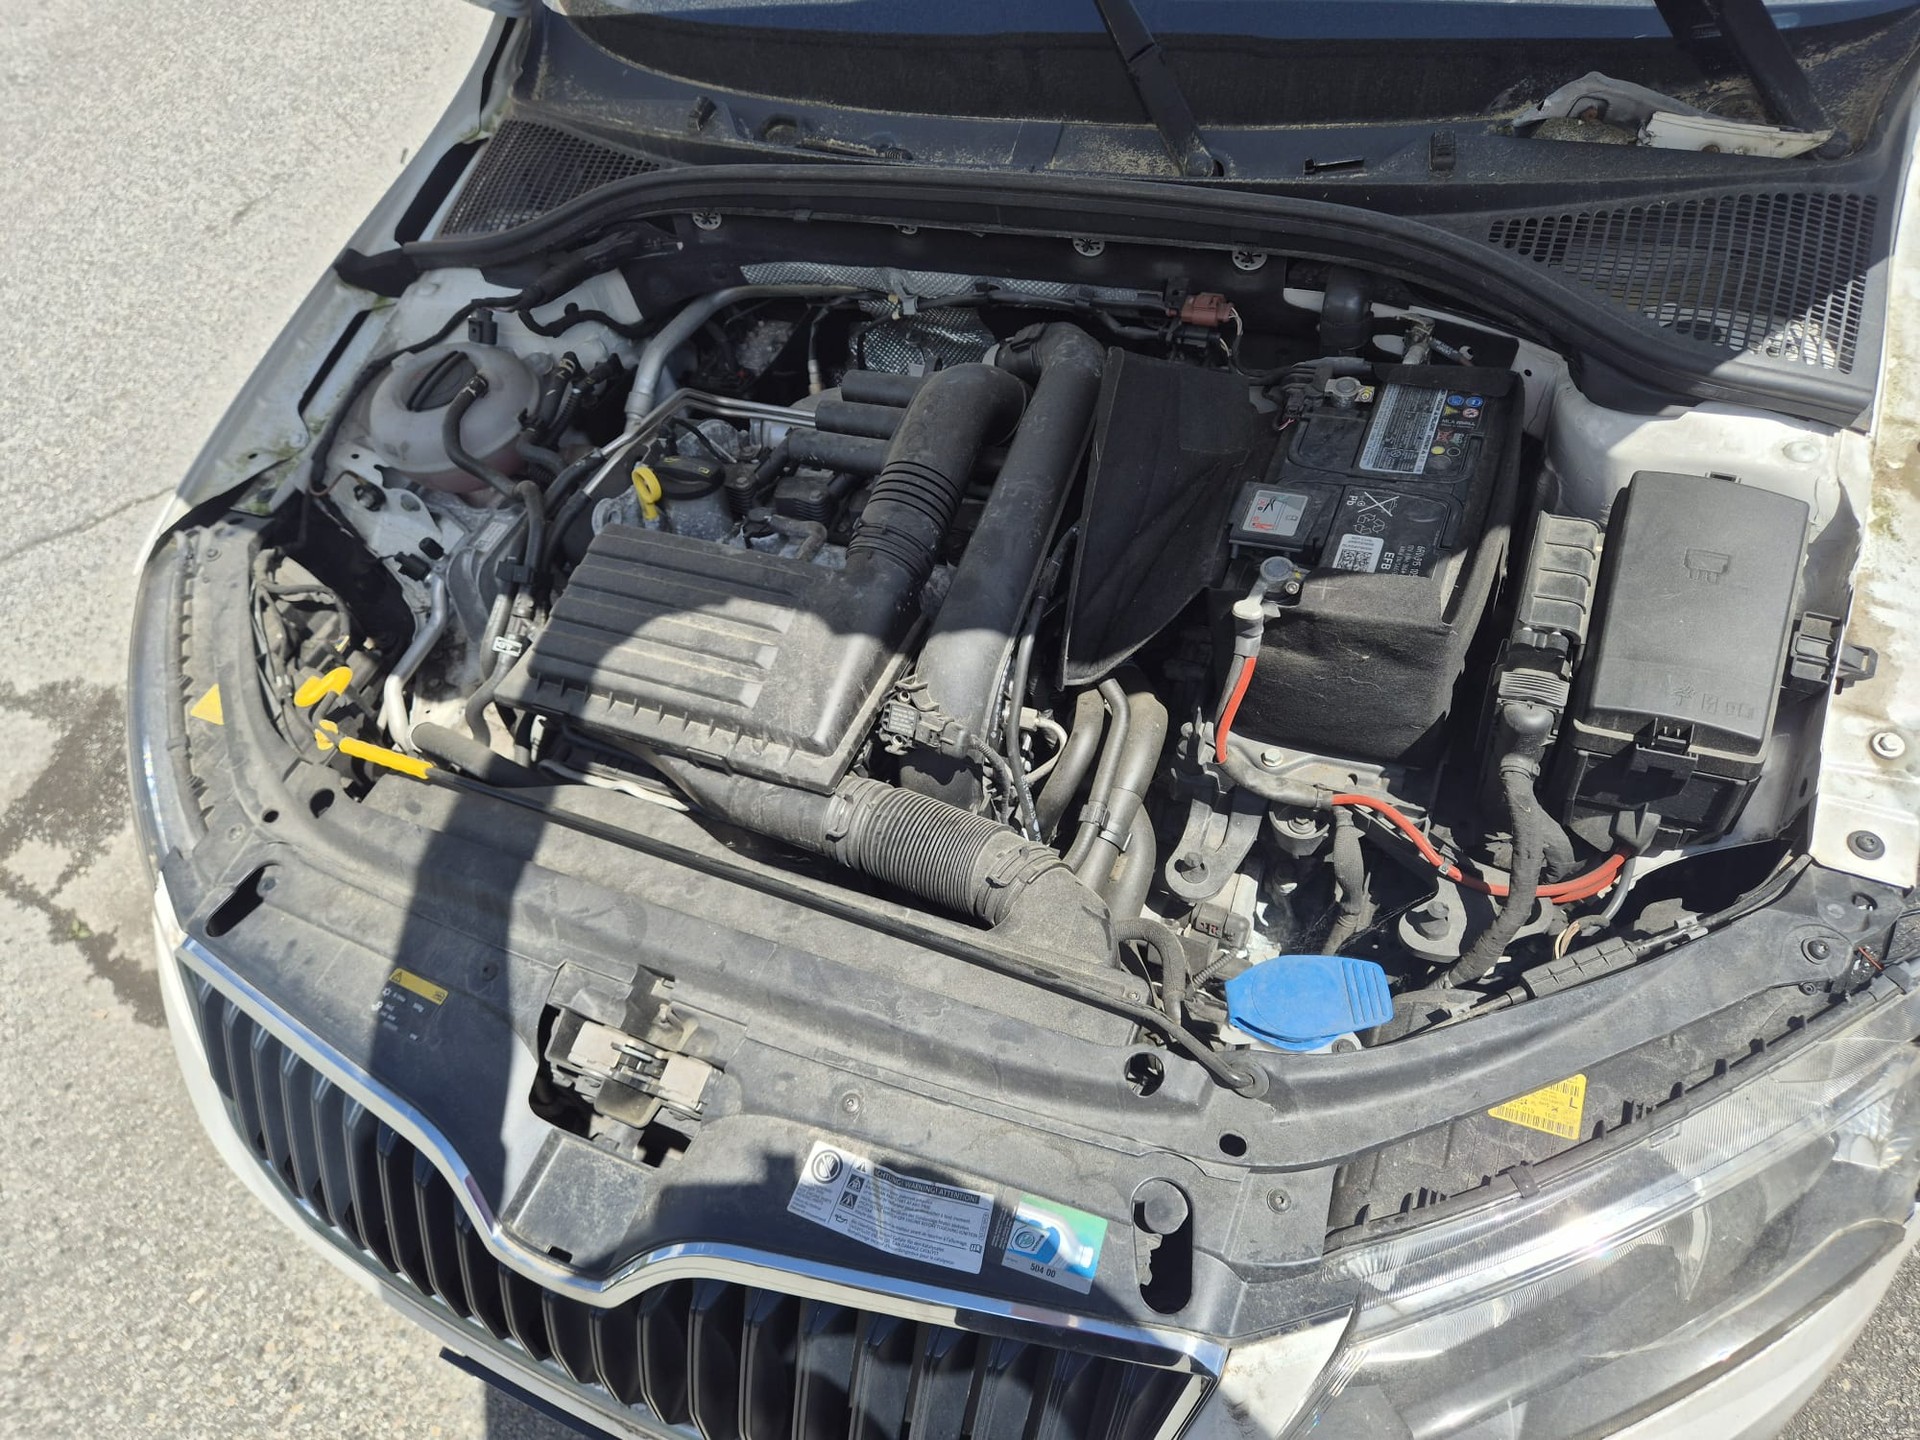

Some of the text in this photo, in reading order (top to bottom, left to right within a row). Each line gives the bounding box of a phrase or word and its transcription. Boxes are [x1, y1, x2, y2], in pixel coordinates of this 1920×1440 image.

[1346, 495, 1358, 505] Pb
[1380, 551, 1395, 570] EFB
[1569, 1096, 1578, 1109] L
[905, 1180, 938, 1195] WARNING!
[940, 1188, 978, 1204] ATTENTION!
[1030, 1262, 1056, 1278] 504 00
